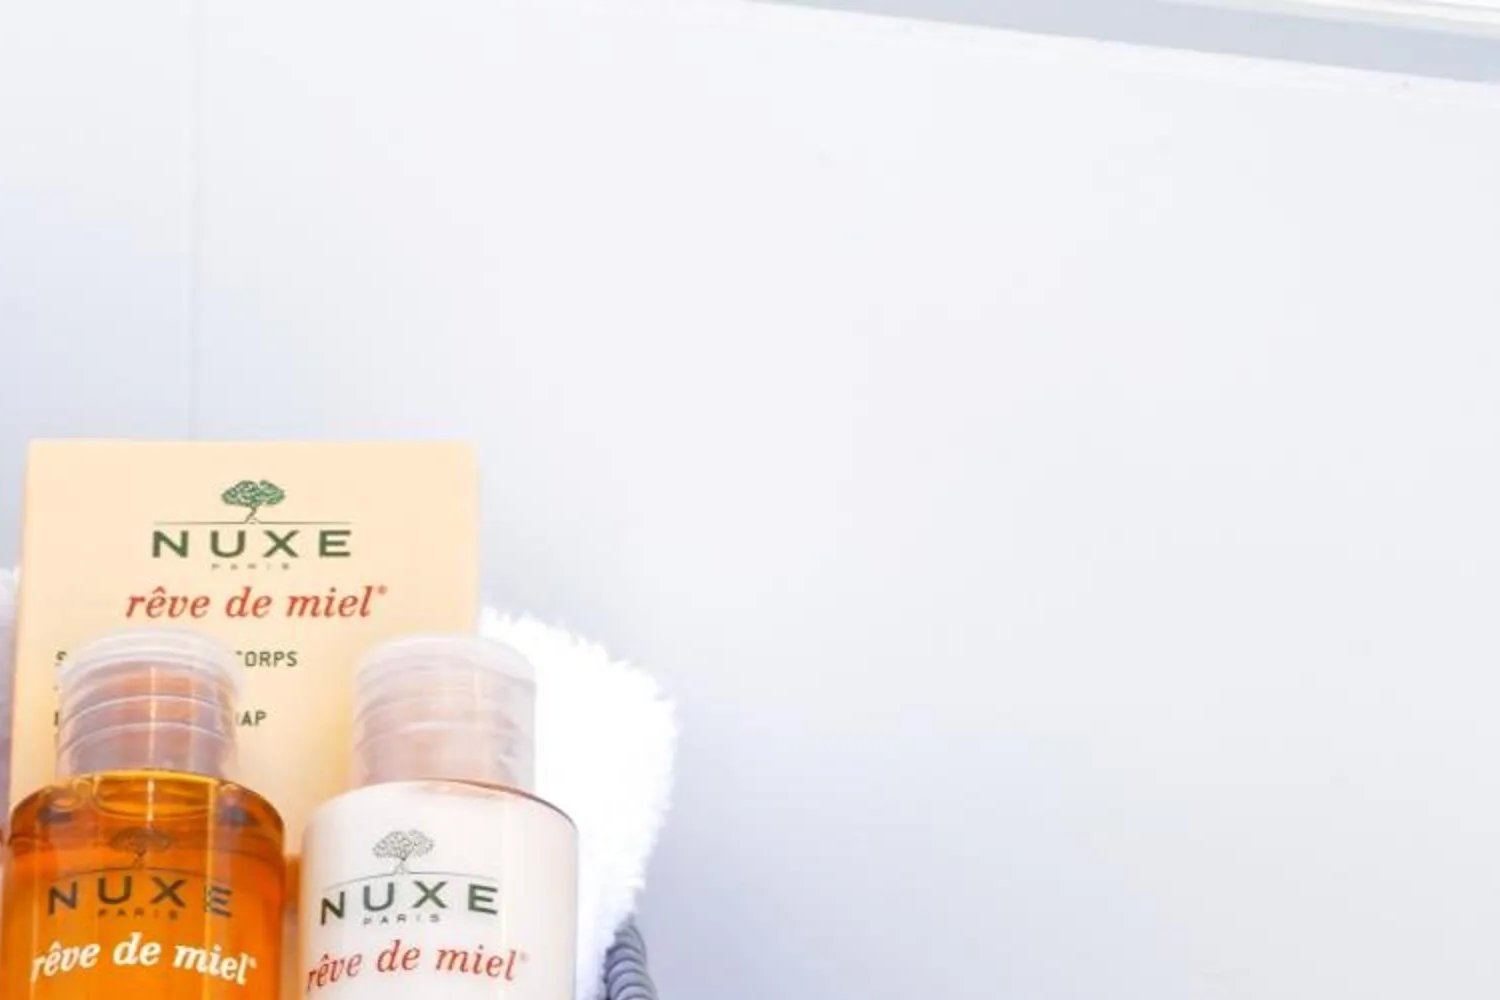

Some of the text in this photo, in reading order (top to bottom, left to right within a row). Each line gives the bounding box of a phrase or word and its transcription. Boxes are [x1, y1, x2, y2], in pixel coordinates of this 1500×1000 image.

[152, 529, 353, 558] NUXE
[125, 585, 211, 619] rêve
[224, 585, 274, 618] de
[235, 650, 299, 668] ORPS
[47, 875, 233, 918] NUXE
[98, 907, 179, 920] PARIS
[319, 879, 499, 927] NUXE
[363, 912, 442, 925] PARIS
[30, 941, 101, 983] rêve
[112, 931, 162, 967] de
[306, 952, 364, 993] rêve
[376, 939, 422, 973] de
